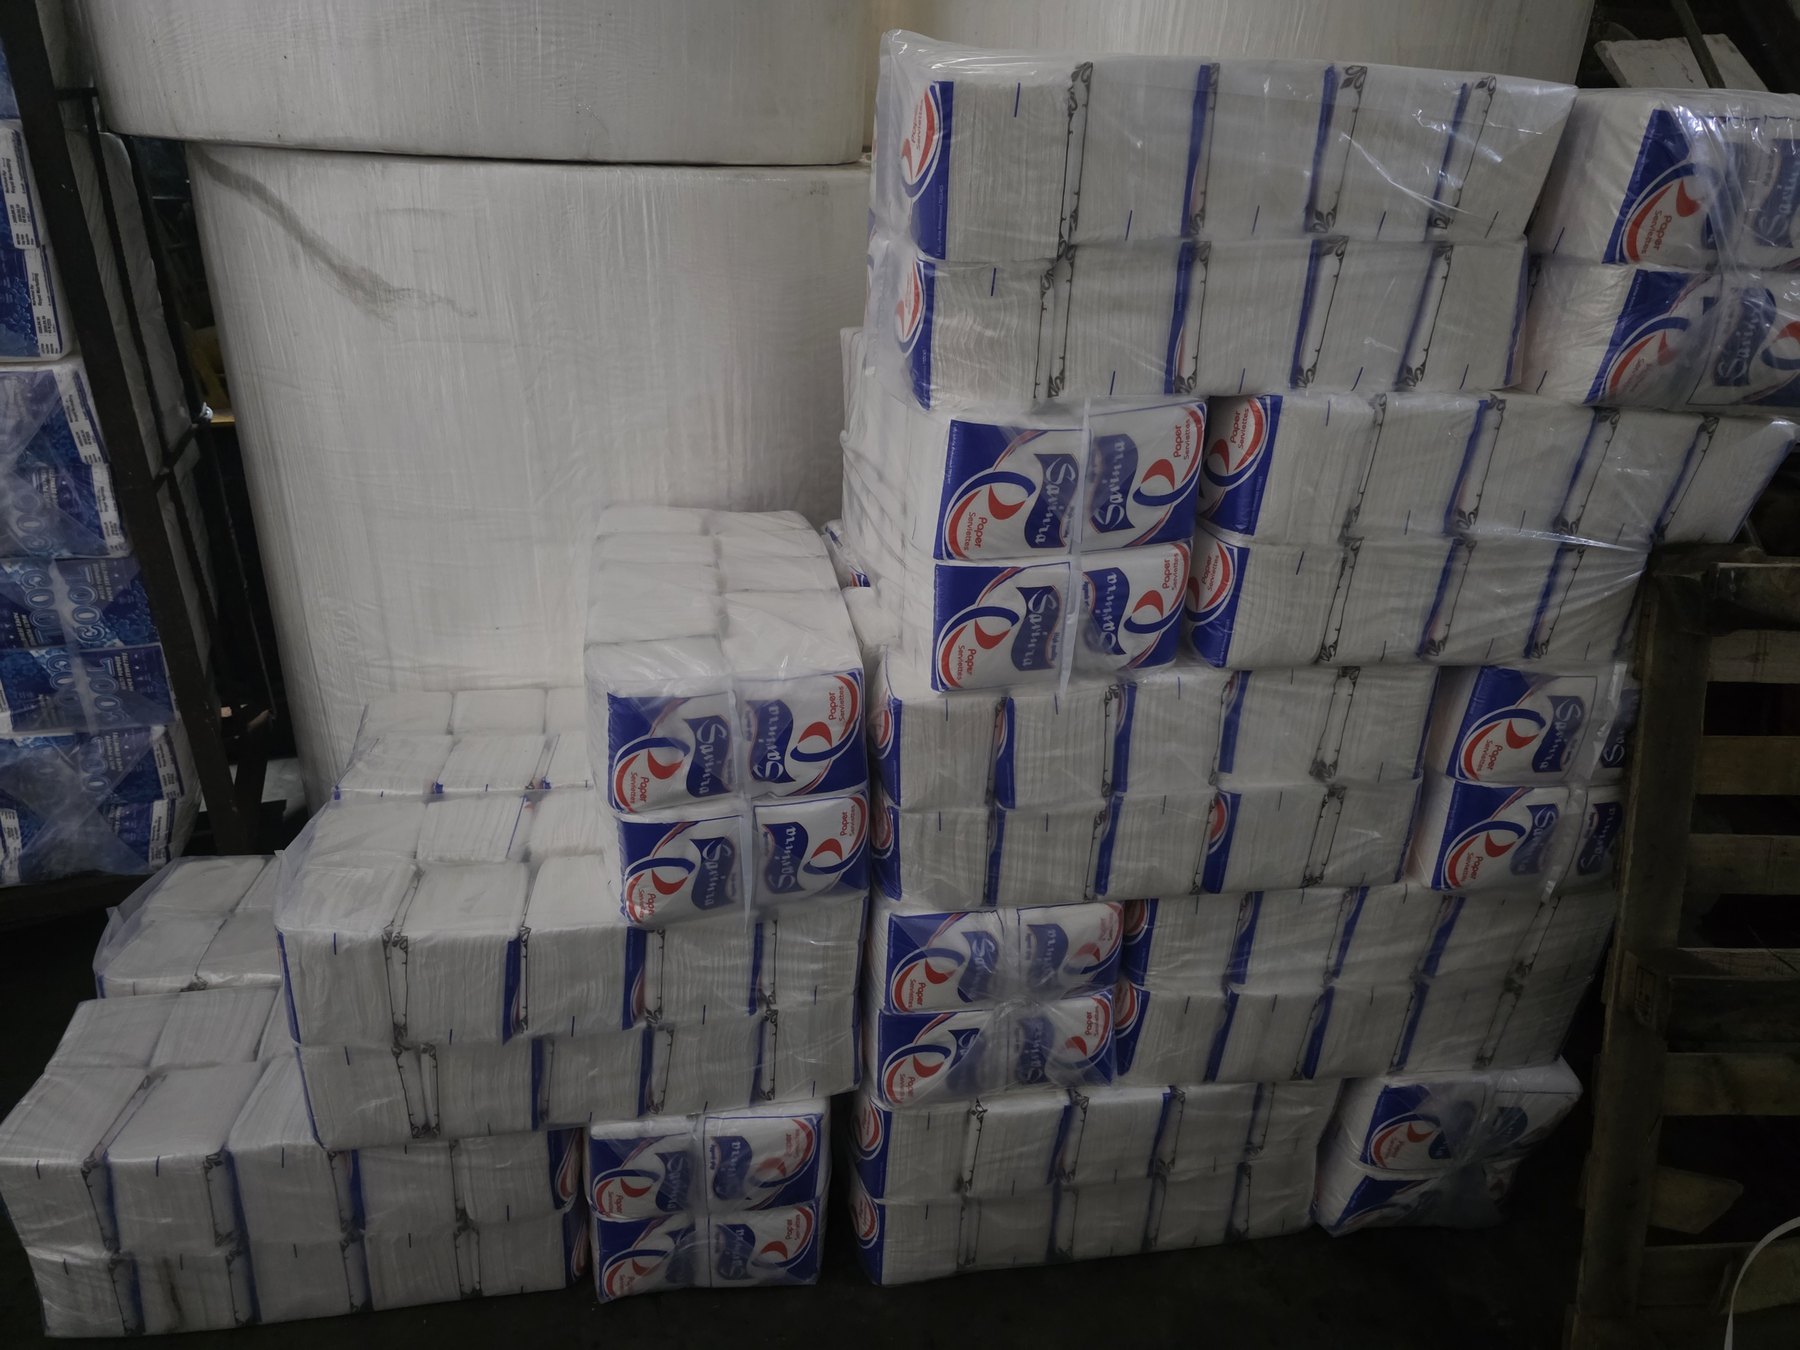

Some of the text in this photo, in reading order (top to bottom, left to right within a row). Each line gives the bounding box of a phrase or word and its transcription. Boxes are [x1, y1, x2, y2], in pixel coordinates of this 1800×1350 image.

[1641, 209, 1663, 254] Serviettes
[1653, 214, 1673, 251] Paper
[1173, 424, 1182, 458] Paper
[1182, 418, 1191, 460] Serviettes
[1230, 409, 1241, 444] Paper
[1238, 407, 1249, 449] Serviettes
[963, 511, 977, 551] Serviettes
[974, 516, 988, 549] Paper
[1162, 558, 1171, 589] Paper
[1171, 552, 1180, 591] Serviettes
[1201, 553, 1212, 585] Paper
[1207, 553, 1219, 592] Serviettes
[956, 644, 966, 681] Serviettes
[967, 647, 977, 677] Paper
[828, 691, 837, 721] Paper
[1476, 738, 1493, 772] Serviettes
[1487, 744, 1503, 771] Paper
[630, 771, 639, 805] Serviettes
[640, 776, 650, 803] Paper
[840, 810, 848, 836] Paper
[1470, 856, 1484, 880] Paper
[907, 978, 917, 1009] Serviettes
[915, 982, 926, 1006] Paper
[1085, 1011, 1093, 1036] Paper
[615, 1194, 624, 1214] Paper
[785, 1218, 793, 1240] Paper
